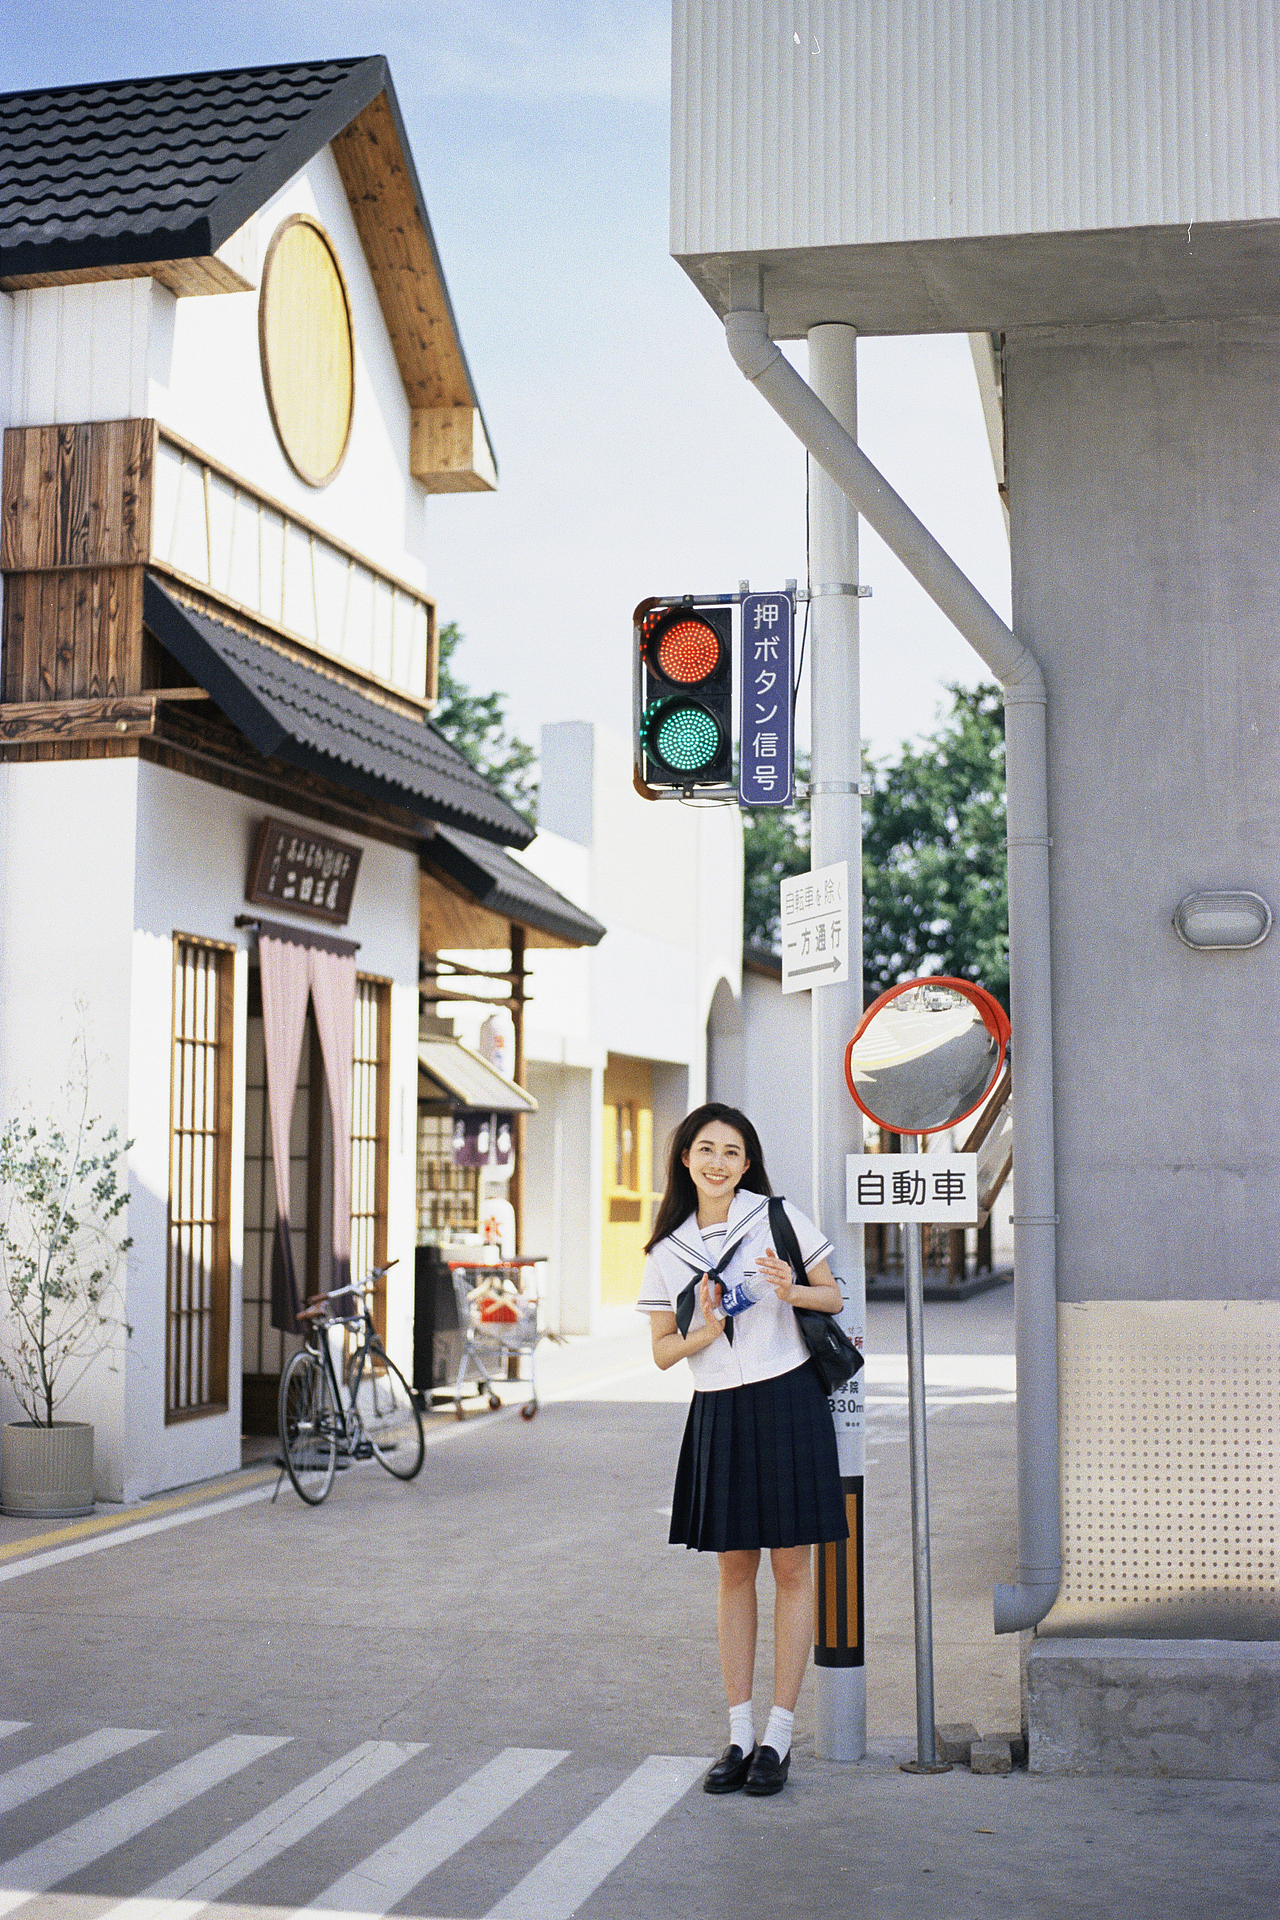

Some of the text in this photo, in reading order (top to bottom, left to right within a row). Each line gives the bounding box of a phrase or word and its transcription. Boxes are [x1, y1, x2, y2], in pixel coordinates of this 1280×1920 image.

[752, 604, 780, 791] 押ボタン信号
[786, 878, 842, 915] 自転車を除く
[787, 920, 842, 956] 一方通行
[857, 1168, 967, 1206] 自動車
